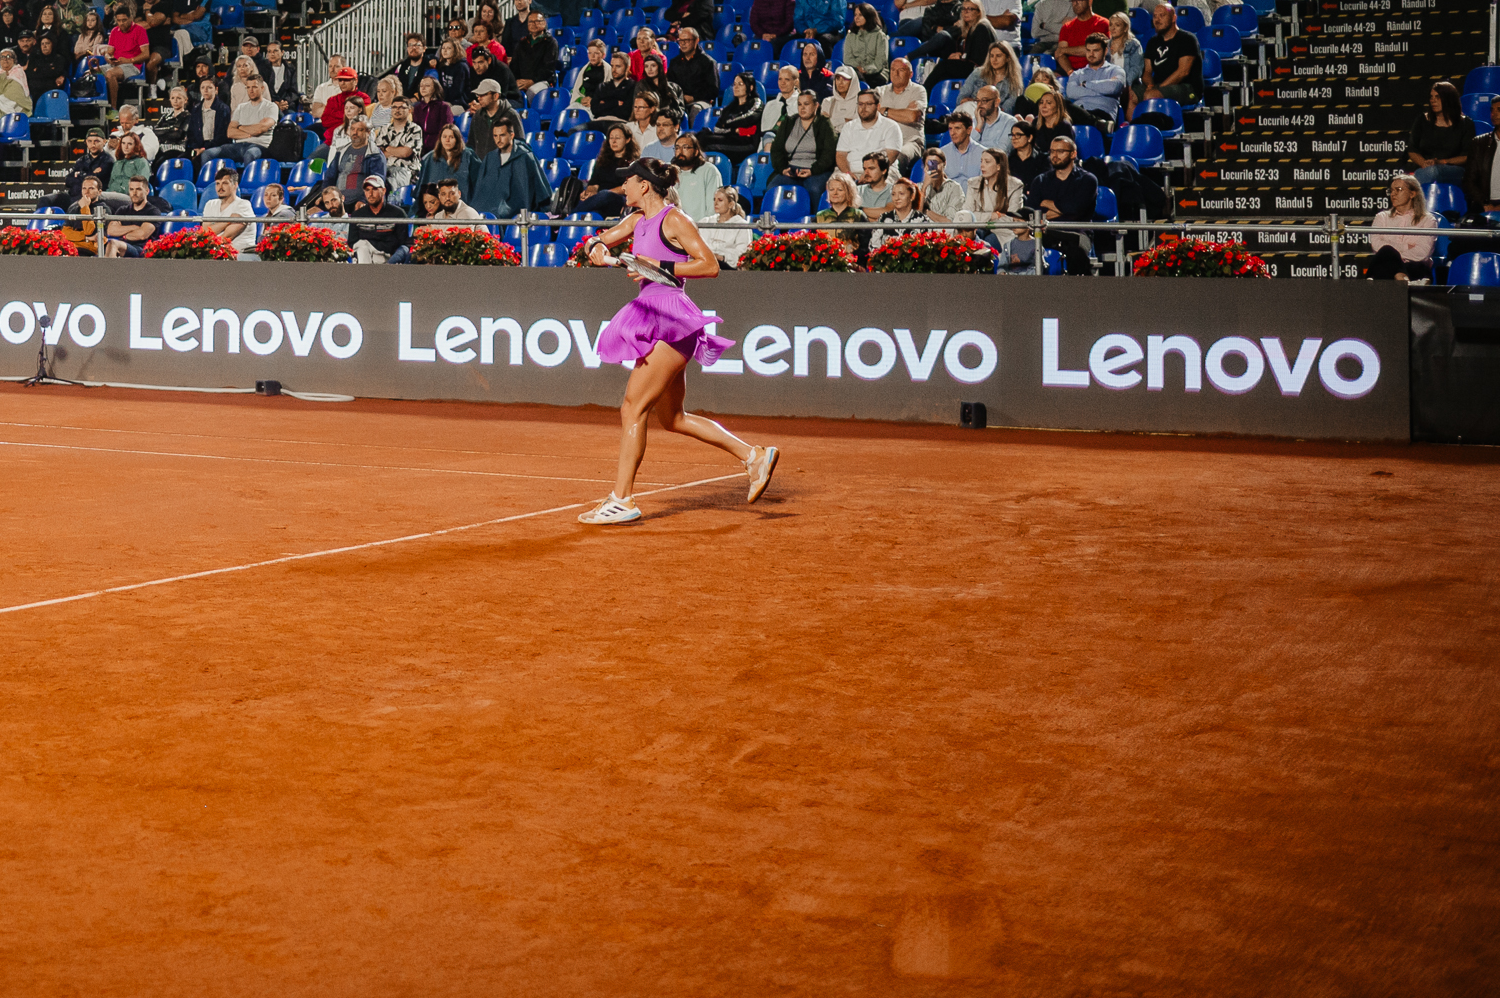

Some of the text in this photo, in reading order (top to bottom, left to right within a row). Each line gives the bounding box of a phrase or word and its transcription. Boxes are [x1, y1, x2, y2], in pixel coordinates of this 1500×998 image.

[1340, 1, 1367, 11] Locurile
[1369, 0, 1391, 10] 44-29
[1323, 20, 1422, 33] Locurile 44-29 Rândul 12
[1309, 41, 1409, 54] Locurile 44-29 Rândul 11
[1293, 62, 1396, 75] Locurile 44-29 Rândul 10
[1277, 86, 1380, 99] Locurile 44-29 Rândul 9
[1258, 113, 1363, 126] Locurile 44-29 Rândul 8
[1240, 141, 1272, 153] Locurile
[1273, 140, 1298, 152] 52-33
[1312, 139, 1340, 152] Rândul
[1341, 140, 1347, 152] 7
[1359, 140, 1393, 152] Locurile
[1221, 169, 1253, 181] Locurile
[1254, 168, 1279, 181] 52-33
[1293, 167, 1323, 181] Rândul
[1324, 168, 1330, 180] 6
[1342, 168, 1376, 181] Locurile
[1200, 195, 1389, 210] Locurile 52-33 Rândul 5 Locurile 53-56
[1258, 231, 1288, 244] Rândul
[1289, 232, 1297, 244] 4
[1271, 264, 1278, 277] 3
[1290, 264, 1327, 277] Locurile
[129, 293, 364, 360] Lenovo
[398, 301, 637, 370] Lenov
[1042, 317, 1381, 399] Lenovo
